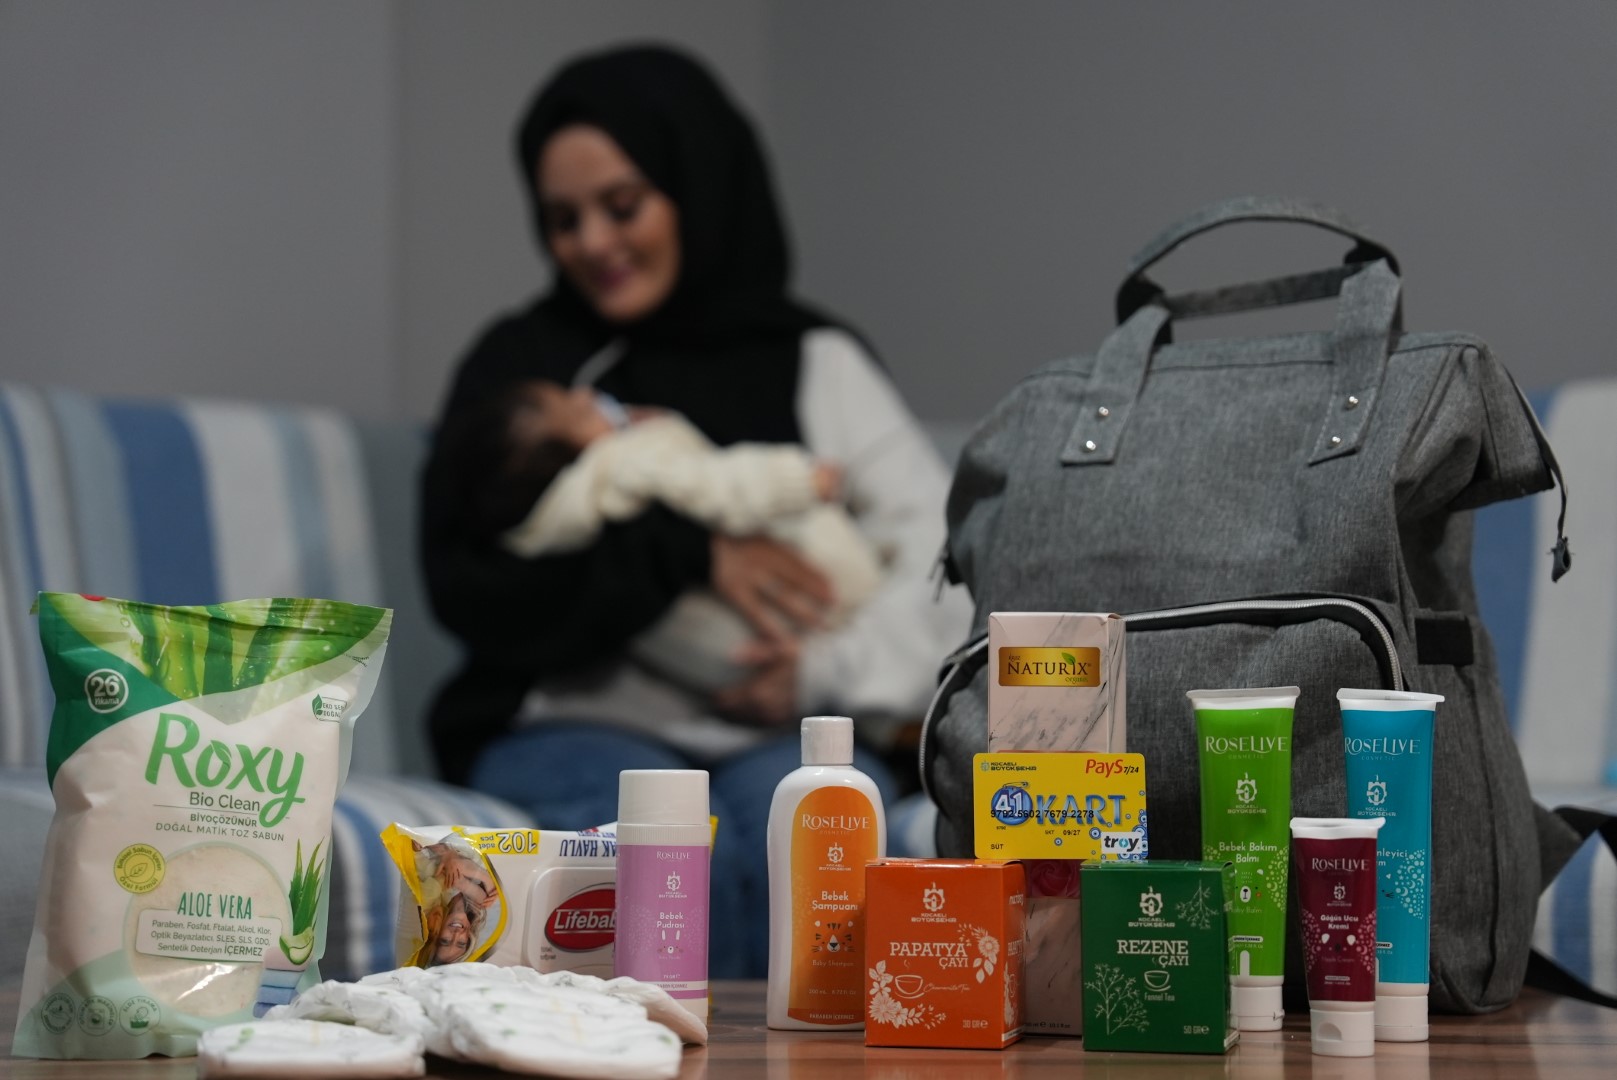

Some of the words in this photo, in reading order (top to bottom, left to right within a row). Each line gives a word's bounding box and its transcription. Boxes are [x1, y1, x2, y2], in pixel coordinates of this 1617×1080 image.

[1008, 661, 1088, 675] NATURIX
[90, 675, 120, 697] 26
[145, 712, 306, 828] Roxy
[1085, 759, 1124, 778] PayS
[1124, 766, 1139, 775] 7/24
[190, 791, 214, 807] Bio
[218, 794, 260, 812] Clean
[994, 789, 1024, 816] 41
[990, 810, 1014, 818] 9792
[1018, 810, 1040, 818] 5602
[1044, 810, 1068, 818] 7679
[1071, 810, 1094, 818] 2278
[1036, 795, 1126, 825] KART
[190, 812, 258, 828] BİYOÇÖZÜNÜR
[156, 822, 192, 832] DOĞAL
[196, 825, 227, 836] MATİK
[231, 828, 249, 838] TOZ
[252, 831, 284, 842] SABUN
[497, 832, 538, 854] 102
[559, 840, 598, 856] HAVLU
[1104, 836, 1139, 852] troy
[1218, 842, 1246, 852] Bebek
[1249, 842, 1278, 852] Bakım
[1236, 854, 1260, 864] Balmı
[1376, 848, 1408, 859] nleyici
[822, 890, 848, 900] Bebek
[177, 892, 212, 918] ALOE
[220, 894, 252, 920] VERA
[812, 900, 858, 912] Şampuanı
[660, 912, 684, 920] Bebek
[656, 920, 684, 928] Pudrası
[151, 930, 171, 940] Optik
[158, 943, 188, 952] Sentetik
[190, 944, 222, 954] Deterjan
[224, 942, 262, 956] İÇERMEZ
[890, 942, 968, 957] PAPATYA
[1116, 940, 1189, 954] REZENE
[939, 958, 968, 970] ÇAYI
[1158, 956, 1190, 968] ÇAYI
